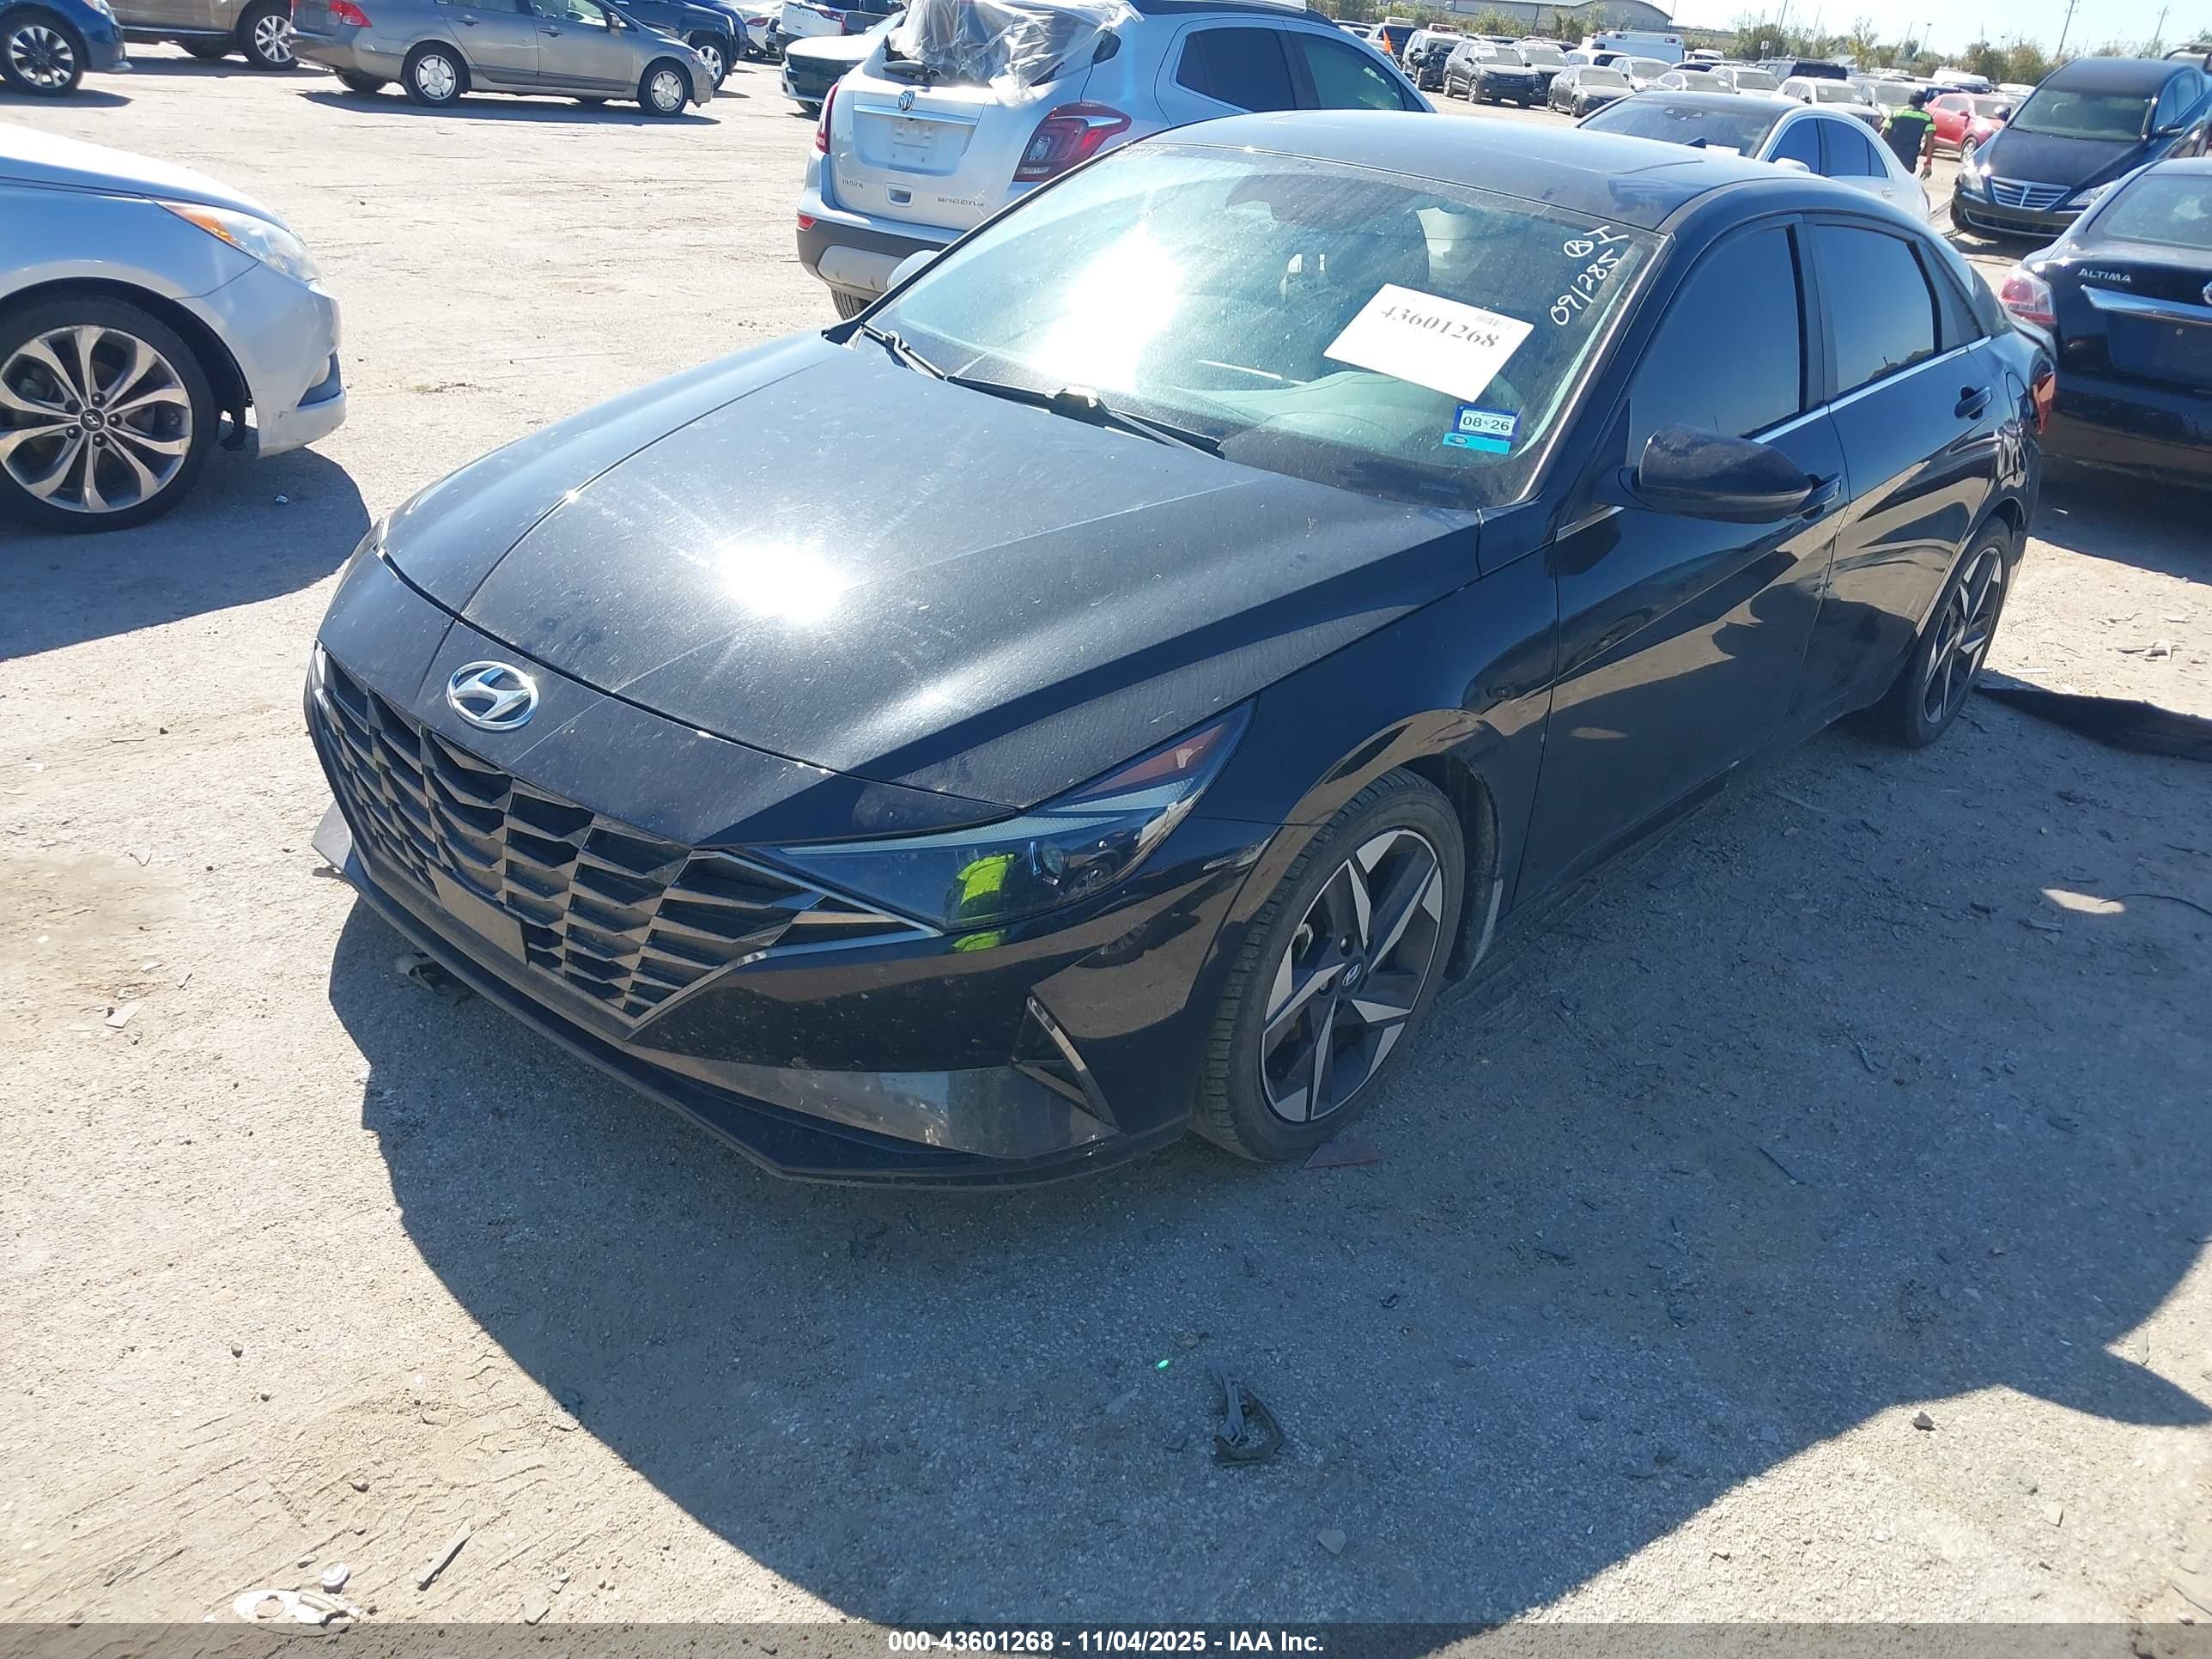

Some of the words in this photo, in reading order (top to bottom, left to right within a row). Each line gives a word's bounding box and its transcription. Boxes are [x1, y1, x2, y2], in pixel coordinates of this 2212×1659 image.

[2078, 267, 2132, 283] ALTIMA
[1380, 305, 1500, 348] 43601268
[1462, 416, 1482, 428] 08
[1490, 419, 1510, 431] 26
